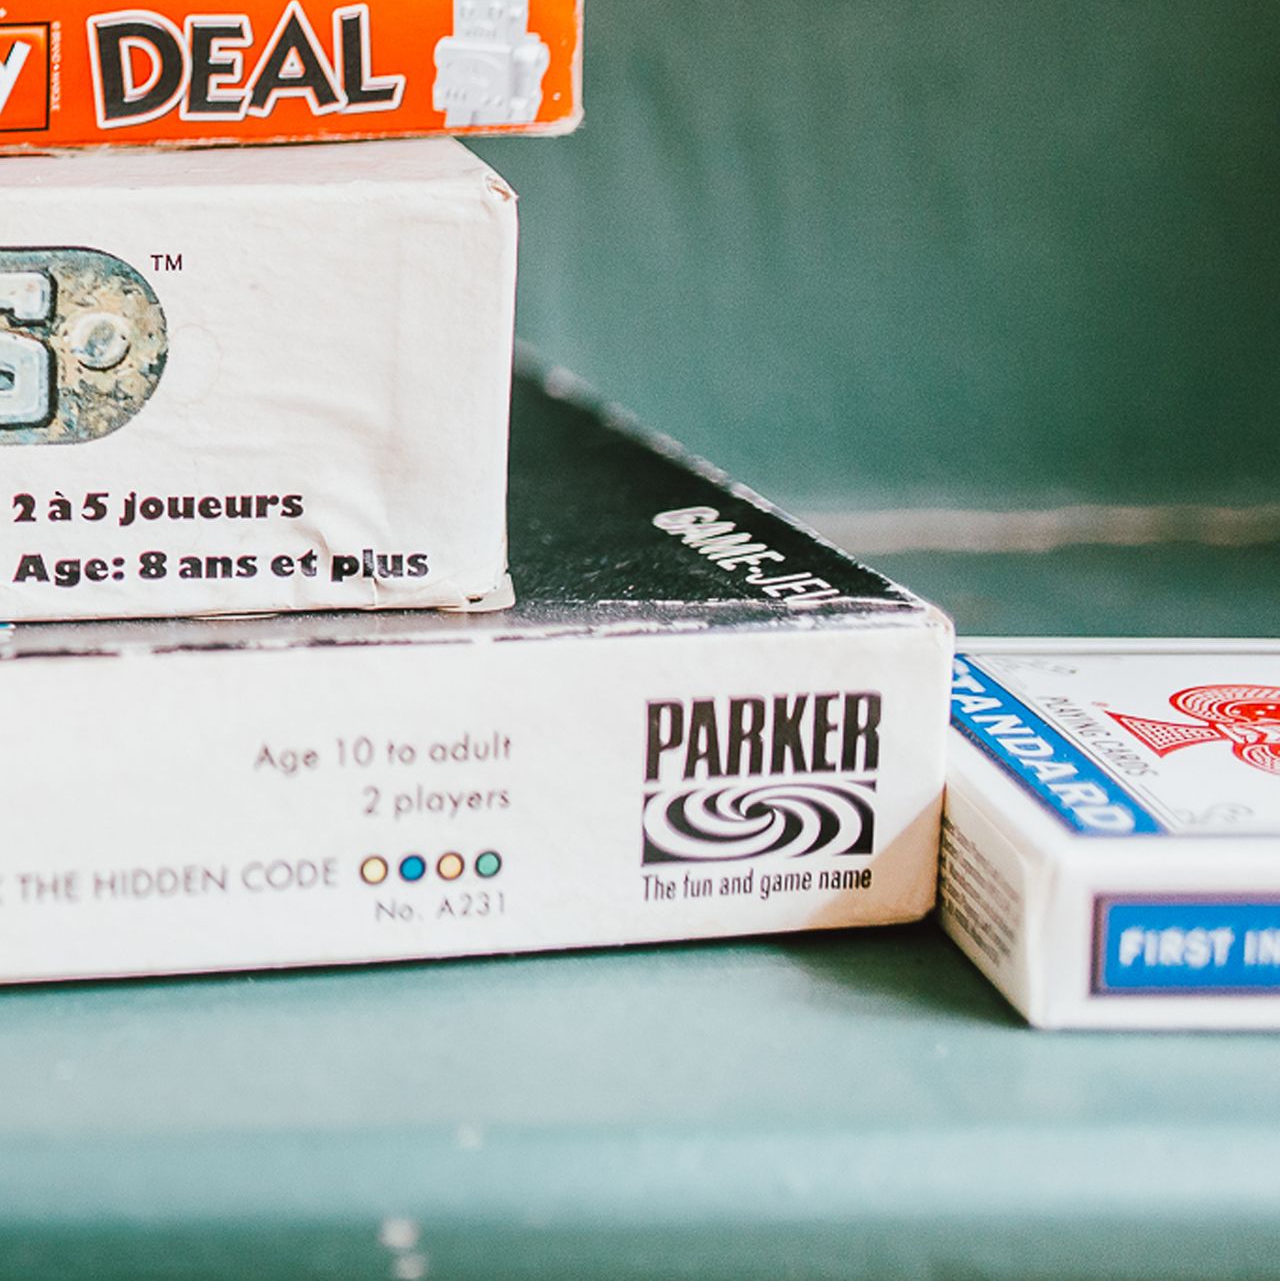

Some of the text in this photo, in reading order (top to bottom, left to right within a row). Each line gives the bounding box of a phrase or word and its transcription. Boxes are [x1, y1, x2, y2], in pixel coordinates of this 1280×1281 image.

[87, 0, 405, 131] DEAL
[151, 253, 183, 272] TM
[12, 493, 37, 523] 2
[81, 492, 109, 521] 5
[119, 492, 304, 527] joueurs
[12, 549, 429, 588] Age: 8 ans et plus
[256, 734, 512, 775] Age 10 to adult
[643, 690, 882, 782] PARKER
[363, 785, 511, 817] 2 players
[17, 872, 81, 903] THE
[93, 866, 228, 899] HIDDEN
[241, 857, 337, 892] CODE
[642, 866, 873, 902] The fun and game name
[438, 891, 506, 919] A231
[1119, 927, 1236, 968] FIRST
